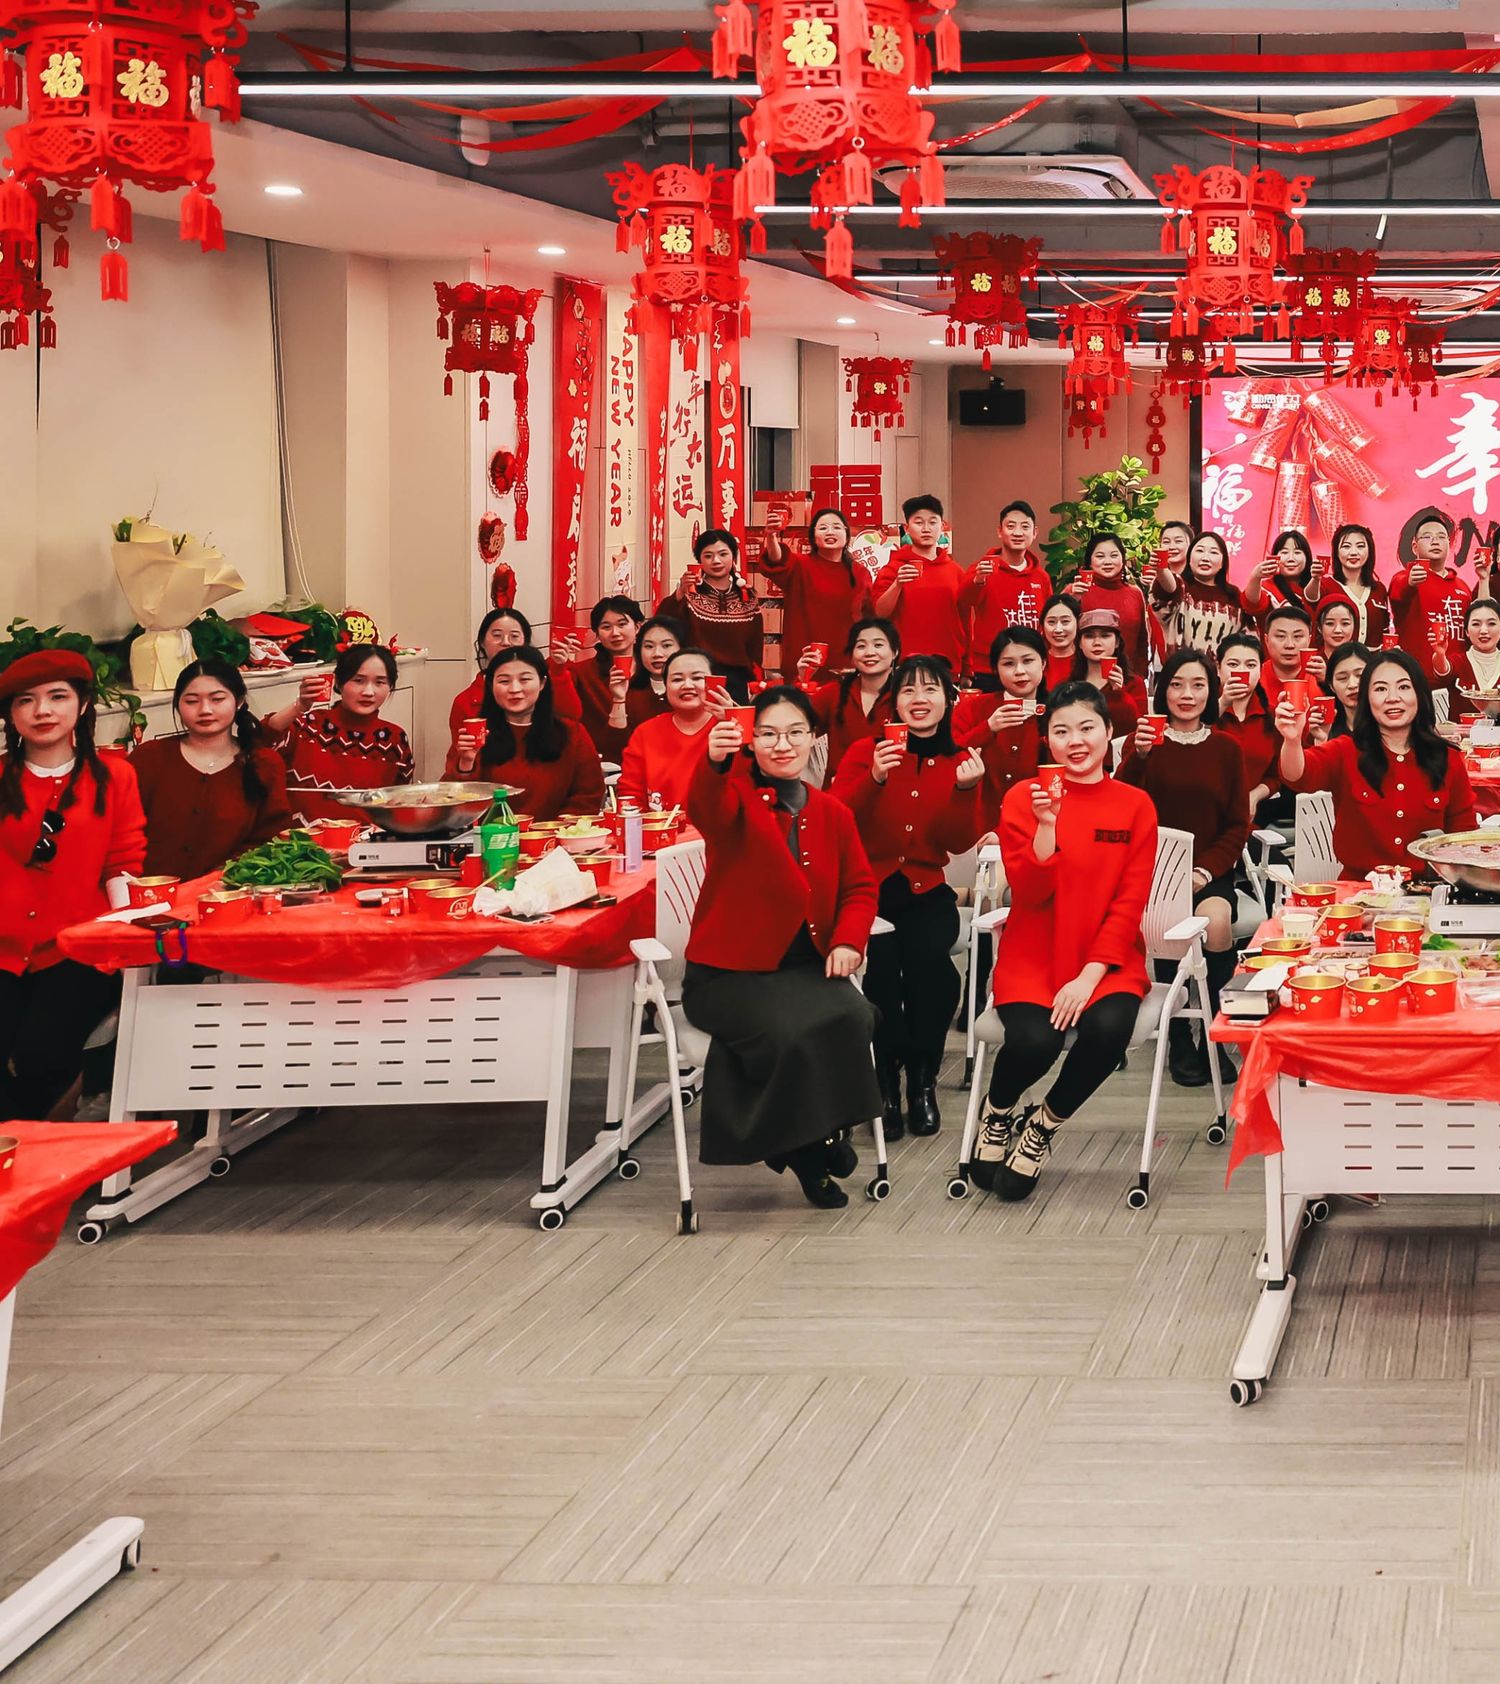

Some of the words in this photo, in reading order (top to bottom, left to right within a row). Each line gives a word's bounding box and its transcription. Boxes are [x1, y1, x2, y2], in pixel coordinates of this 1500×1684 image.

[783, 17, 837, 69] 福
[868, 24, 904, 76] 福
[40, 51, 84, 98] 福
[117, 59, 169, 107] 福
[660, 225, 692, 254] 福
[1207, 226, 1237, 255] 福
[971, 272, 992, 293] 福
[1305, 288, 1322, 307] 福
[1333, 288, 1350, 307] 福
[1087, 335, 1104, 353] 福
[611, 355, 621, 427] NEW
[611, 437, 621, 528] YEAR
